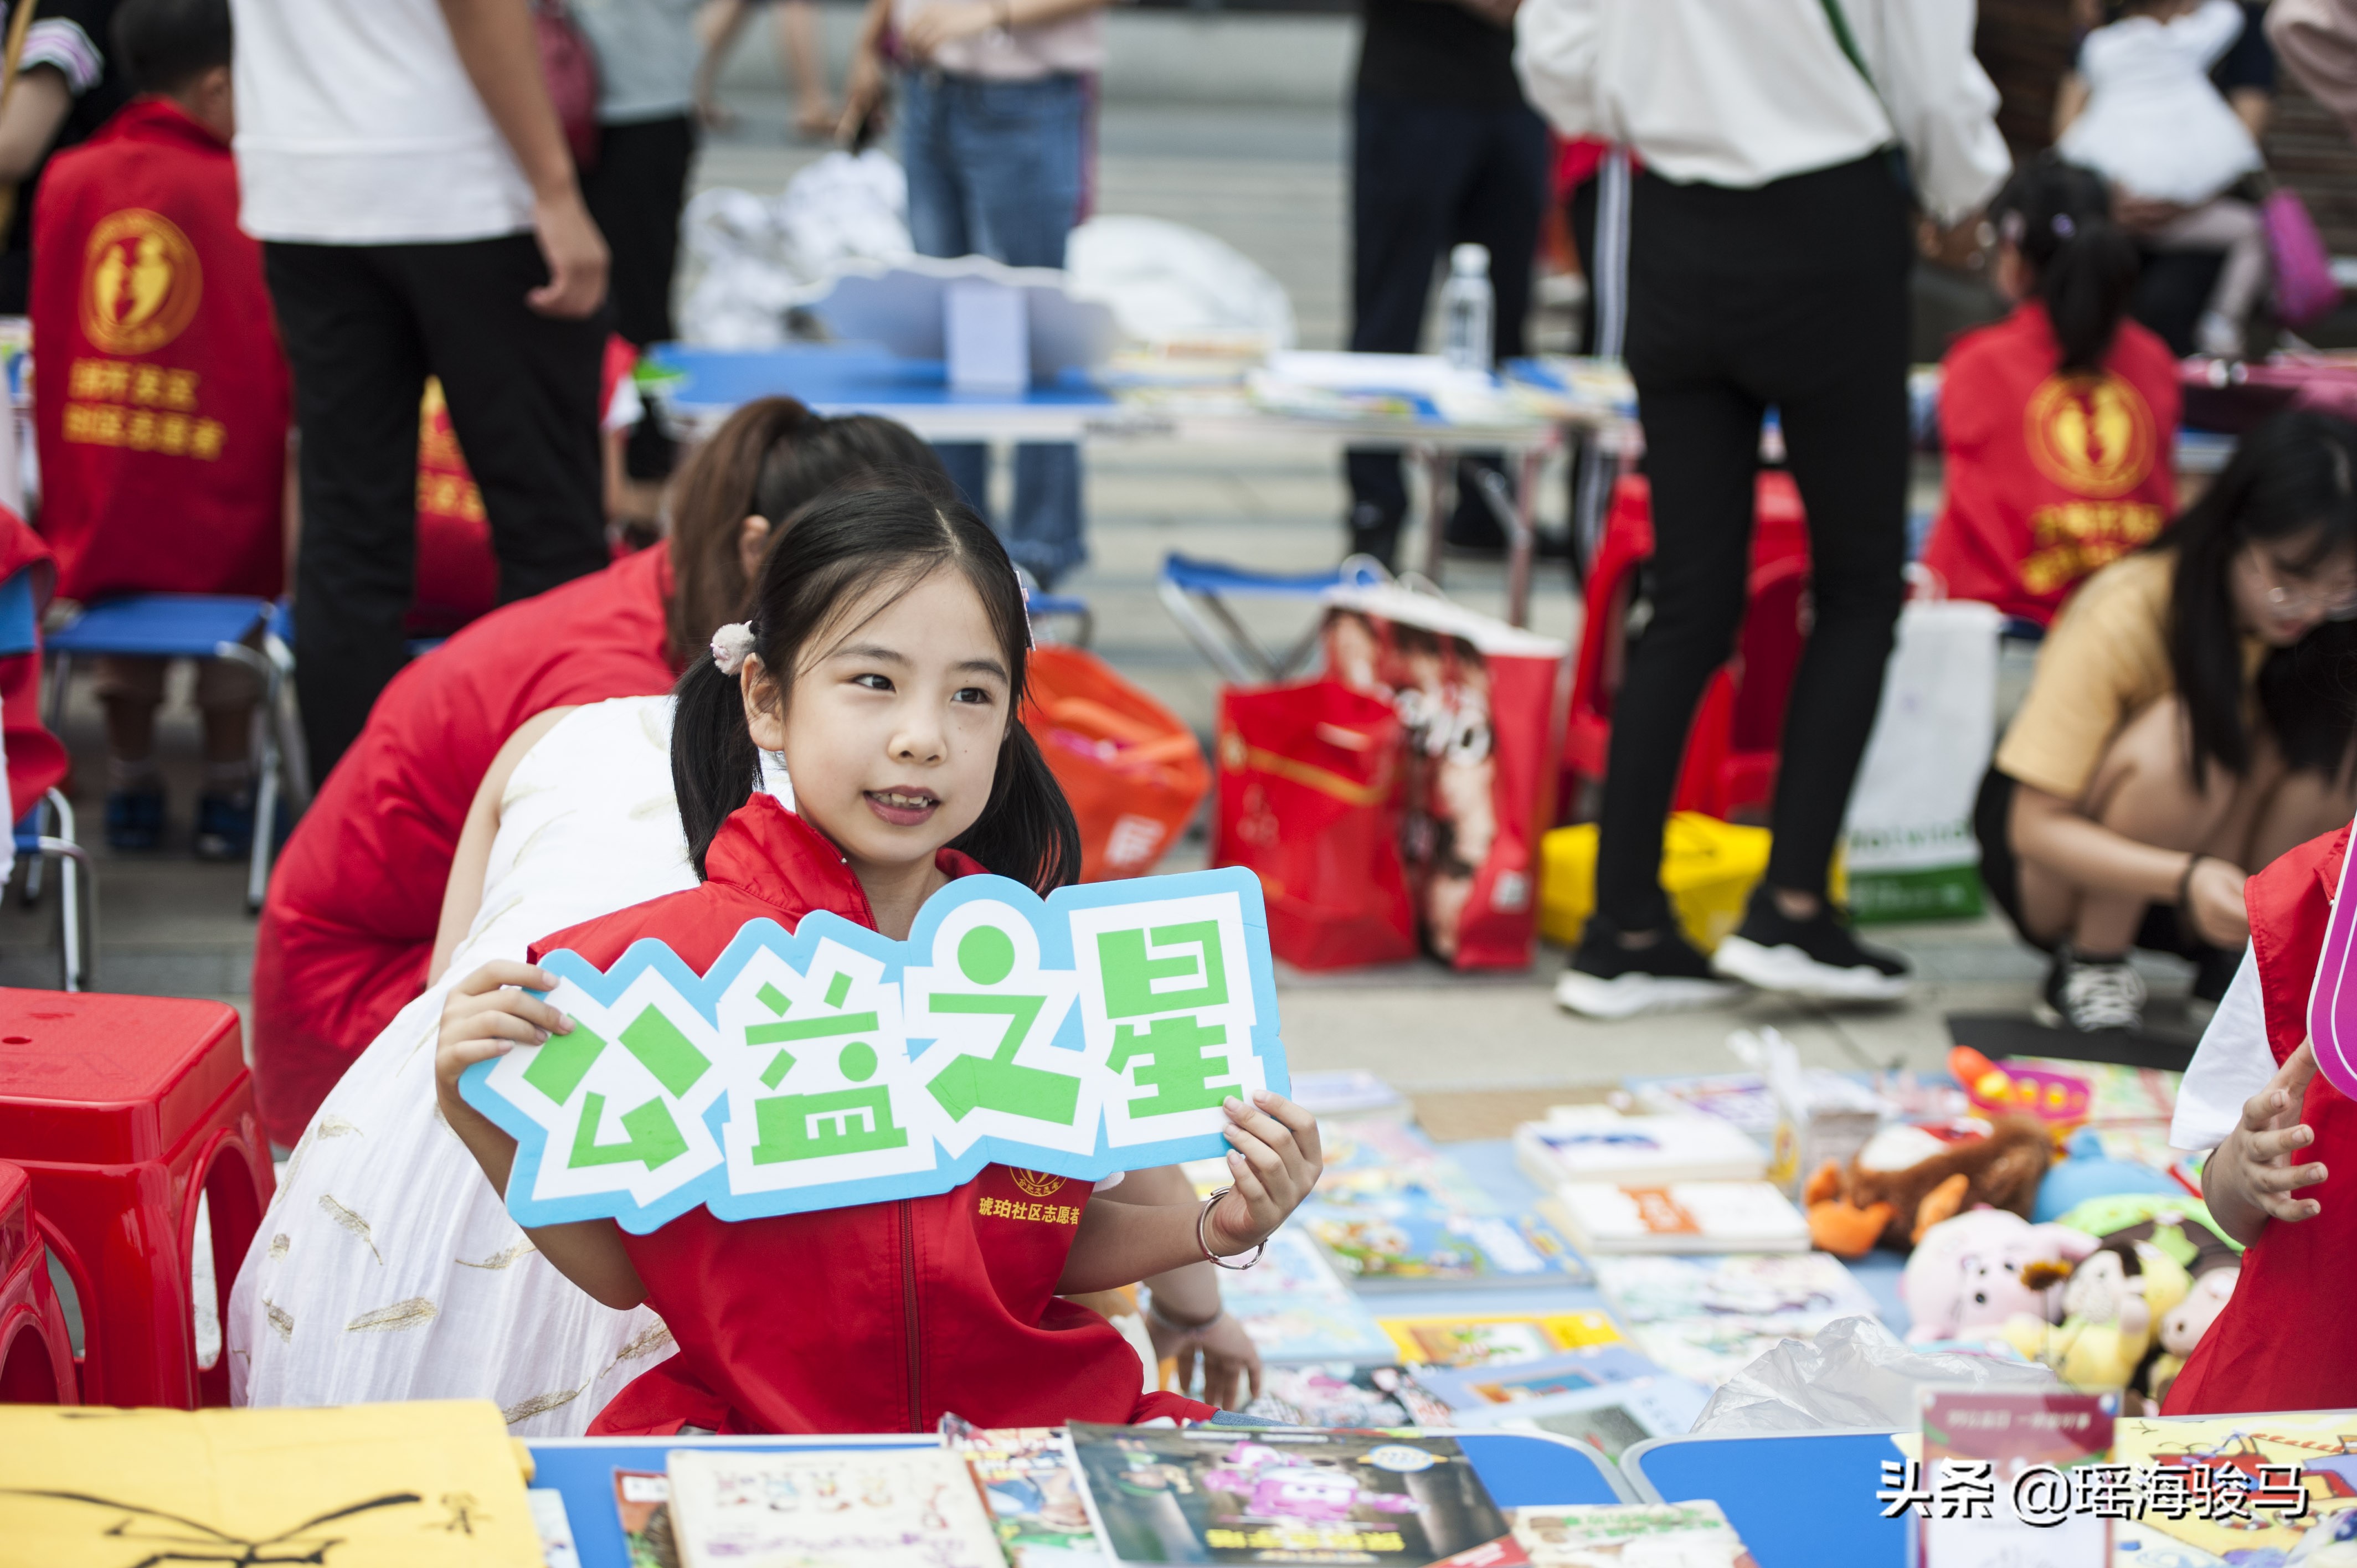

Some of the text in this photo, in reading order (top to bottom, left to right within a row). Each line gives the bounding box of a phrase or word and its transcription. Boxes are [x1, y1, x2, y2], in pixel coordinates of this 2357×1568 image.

[522, 919, 1244, 1172] 公益之星
[1019, 1178, 1059, 1195] 合肥志愿者
[979, 1196, 1080, 1225] 琥珀社区志愿者
